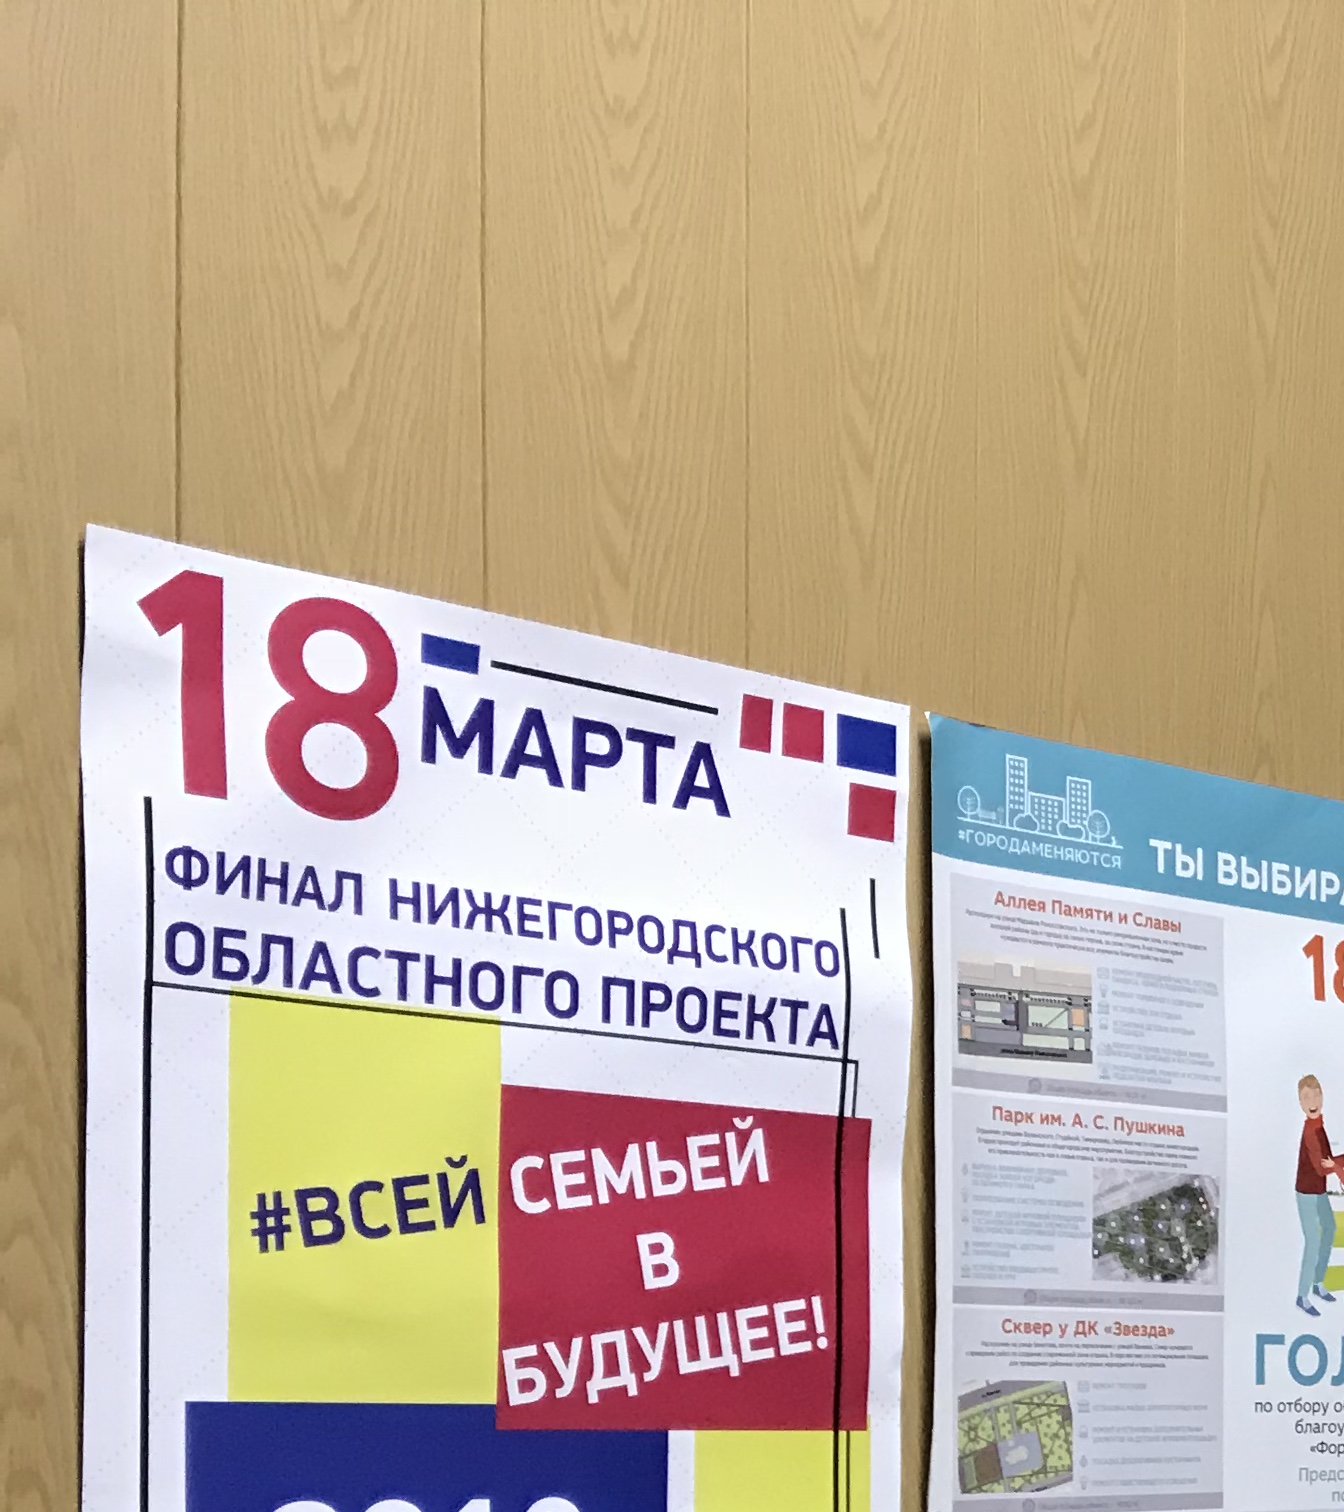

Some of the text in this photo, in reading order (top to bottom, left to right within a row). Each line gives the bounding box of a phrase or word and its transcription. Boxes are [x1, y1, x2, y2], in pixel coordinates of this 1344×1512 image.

[136, 569, 731, 821] 18 МАРТА
[958, 829, 1122, 870] #ГОРОДАМЕНЯЮТСЯ
[1149, 839, 1202, 880] ТЫ
[163, 845, 840, 978] ФИНАЛ НИЖЕГОРОДСКОГО
[994, 891, 1181, 933] Аллея Памяти и Славы
[163, 922, 840, 1050] ОБЛАСТНОГО ПРОЕКТА
[992, 1106, 1185, 1137] Парк им. А. С. Пушкина
[250, 1118, 770, 1253] #ВСЕЙ СЕМЬЕЙ
[637, 1231, 680, 1291] В
[502, 1295, 829, 1406] БУДУЩЕЕ!
[1001, 1319, 1175, 1339] Сквер у ДК «Звезда»
[1254, 1401, 1272, 1413] по
[1278, 1398, 1329, 1416] отбору
